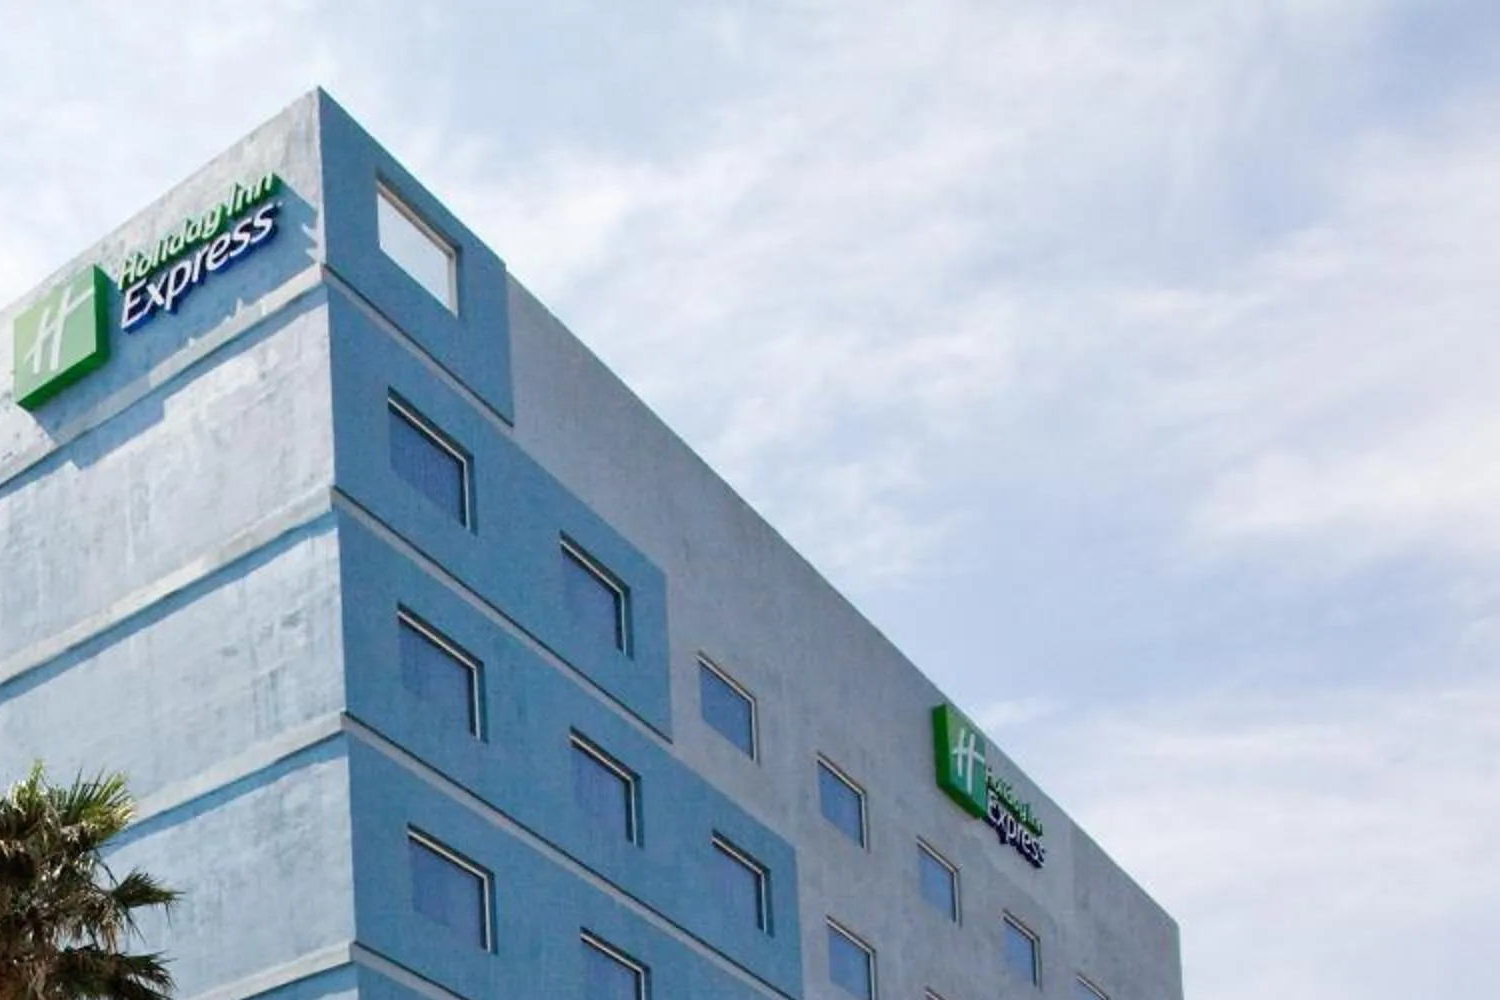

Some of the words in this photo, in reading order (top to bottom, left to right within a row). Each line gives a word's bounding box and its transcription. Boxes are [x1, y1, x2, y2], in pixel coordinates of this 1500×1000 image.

[118, 204, 223, 290] Holiday
[227, 173, 275, 217] Inn
[121, 203, 278, 329] Express
